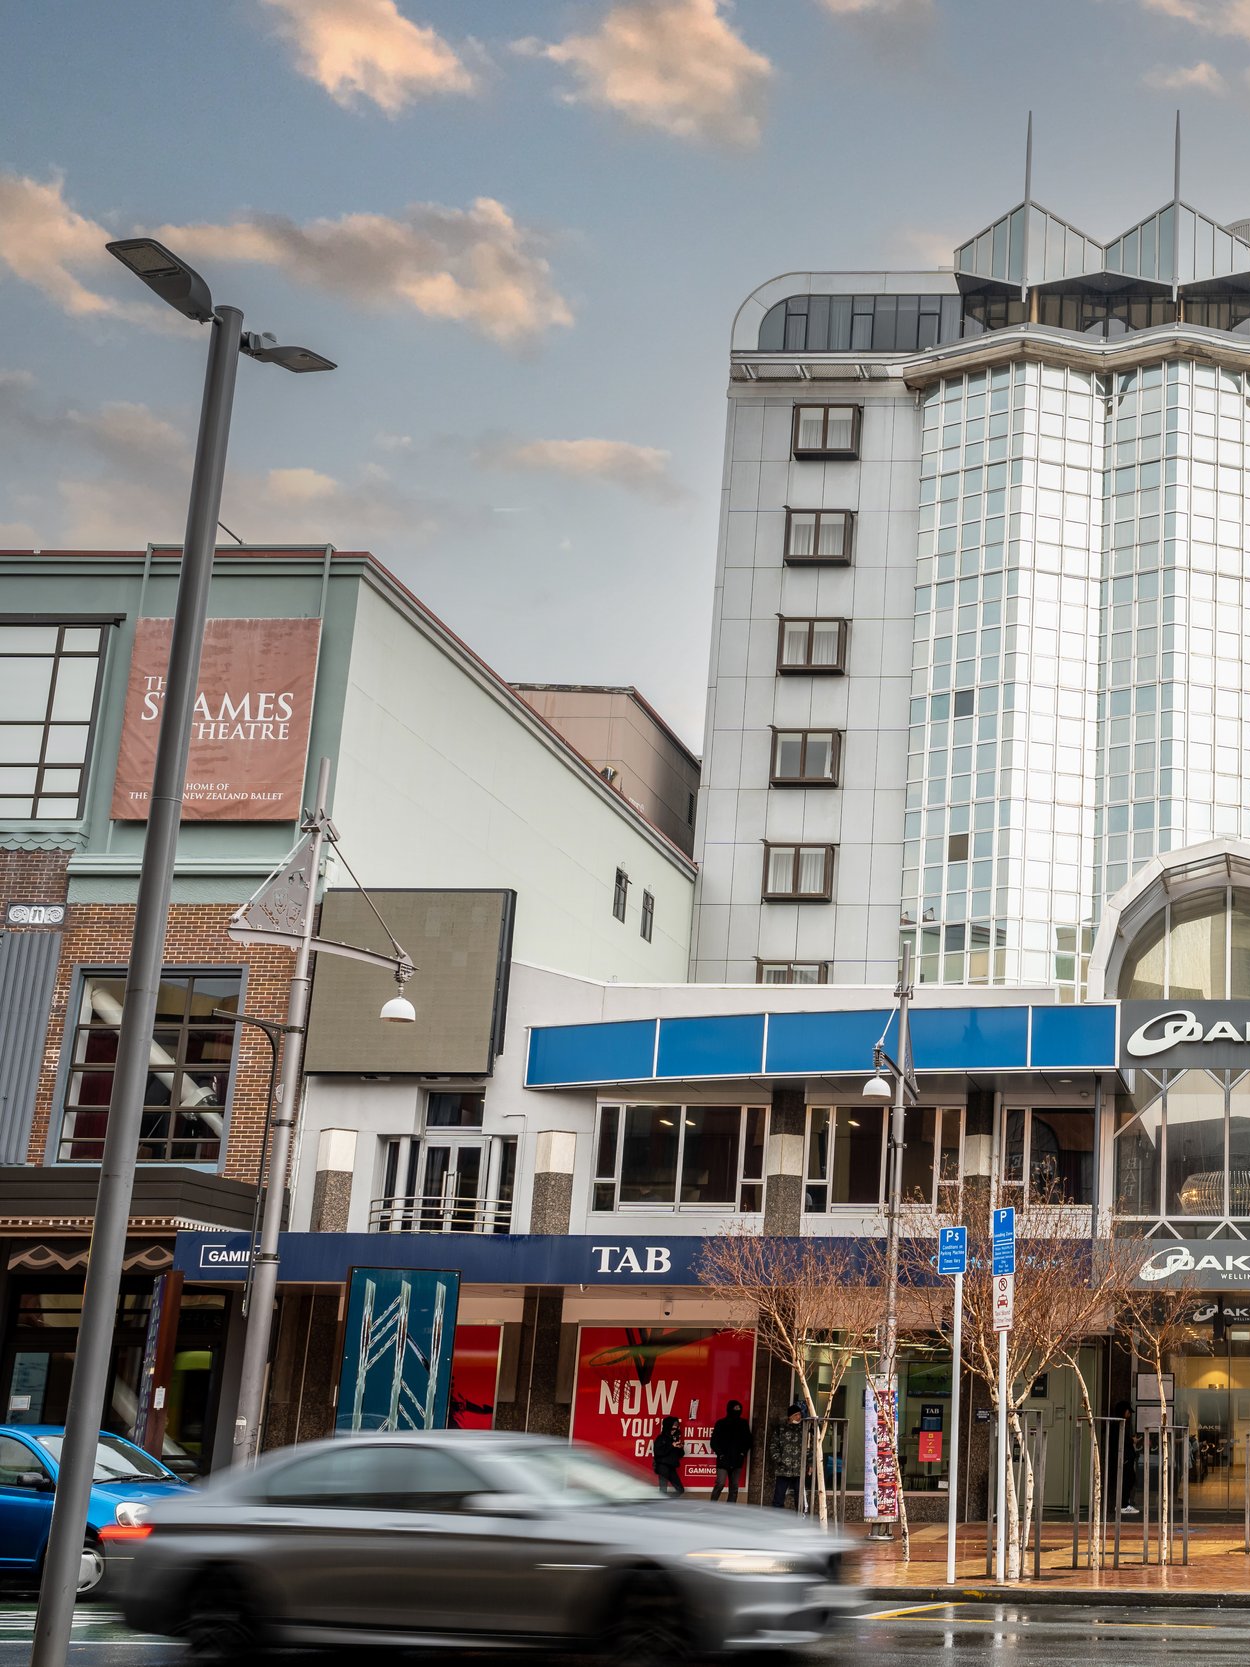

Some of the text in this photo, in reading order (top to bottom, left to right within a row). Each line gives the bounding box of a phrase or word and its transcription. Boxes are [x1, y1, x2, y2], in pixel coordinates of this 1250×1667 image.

[144, 676, 168, 691] TH
[193, 692, 294, 721] AMES
[186, 783, 230, 791] HOME OF
[129, 792, 148, 800] THE
[1000, 1210, 1007, 1223] P
[591, 1246, 672, 1273] TAB
[598, 1379, 679, 1415] NOW
[684, 1427, 715, 1438] IN THE
